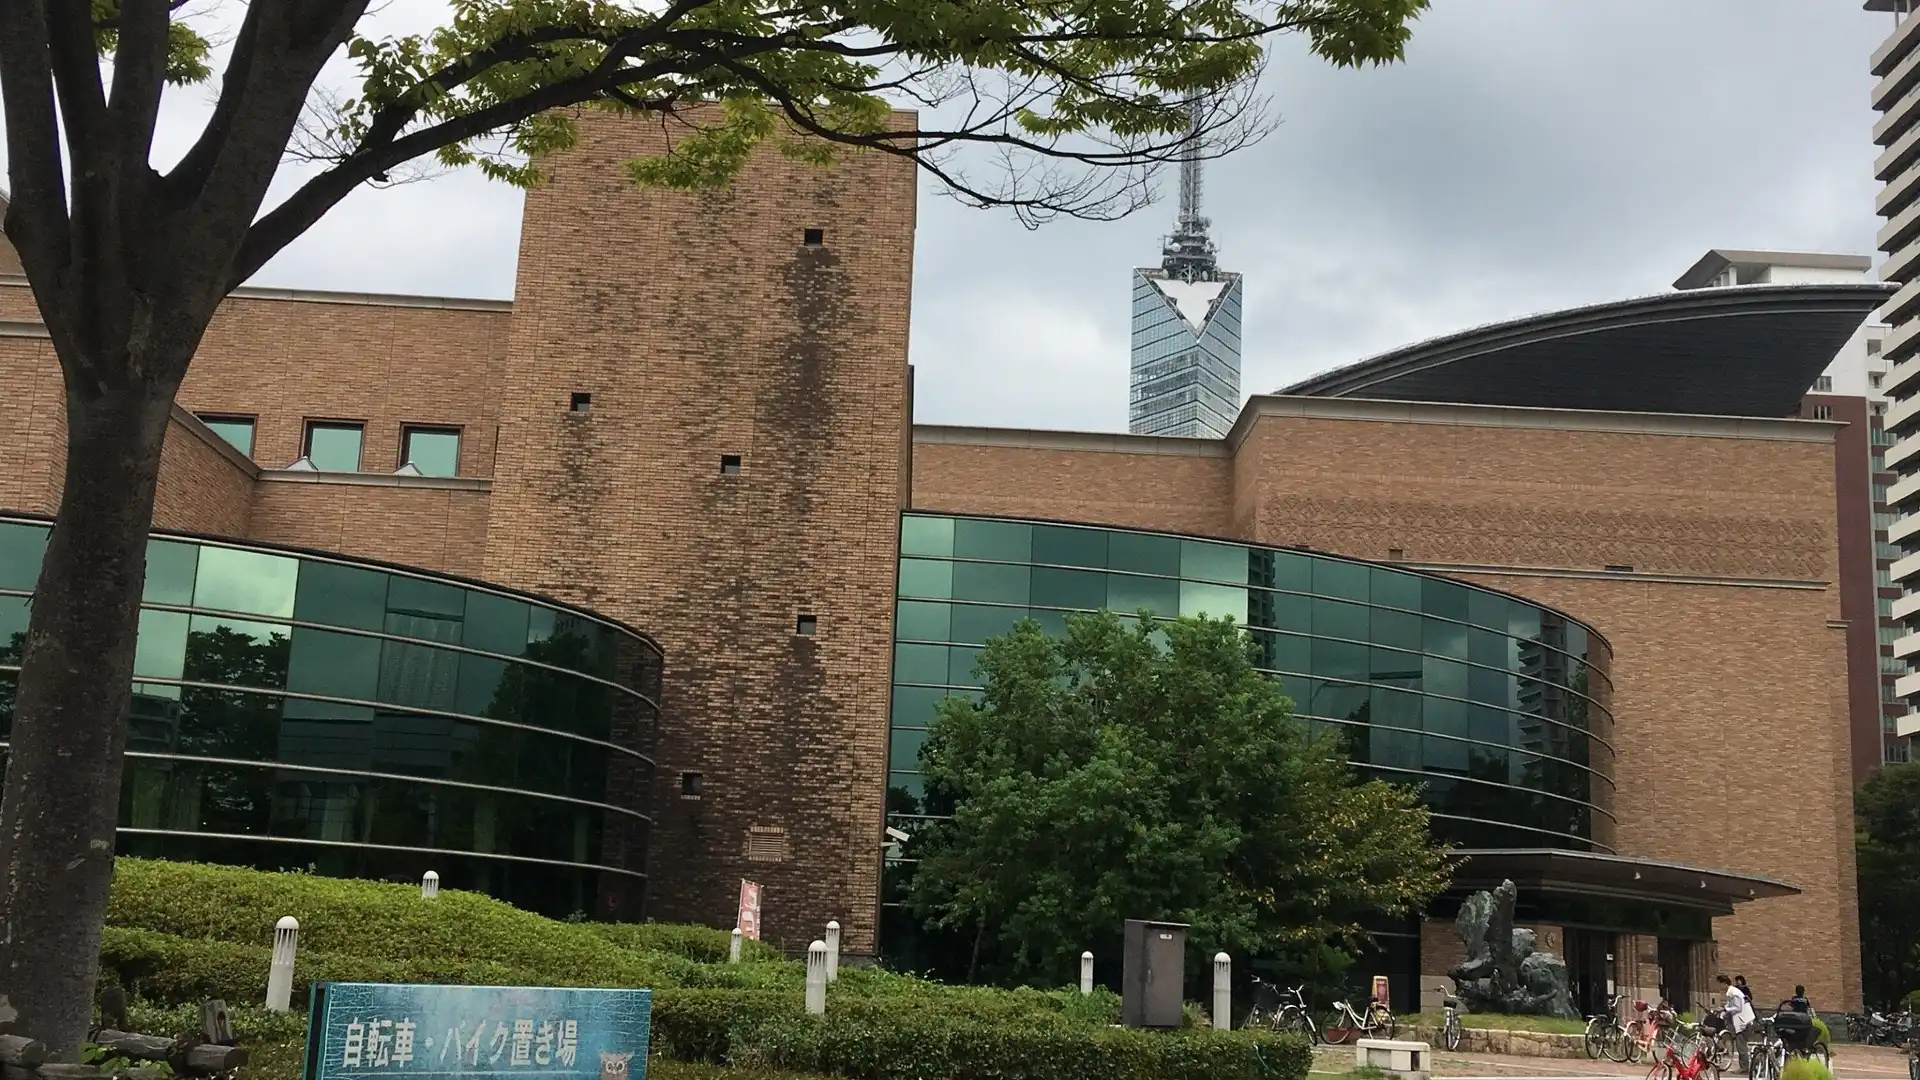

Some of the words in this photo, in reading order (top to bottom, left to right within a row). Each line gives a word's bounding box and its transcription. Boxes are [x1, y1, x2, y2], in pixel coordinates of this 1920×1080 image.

[342, 1017, 577, 1068] 自転車・バイク置き場
